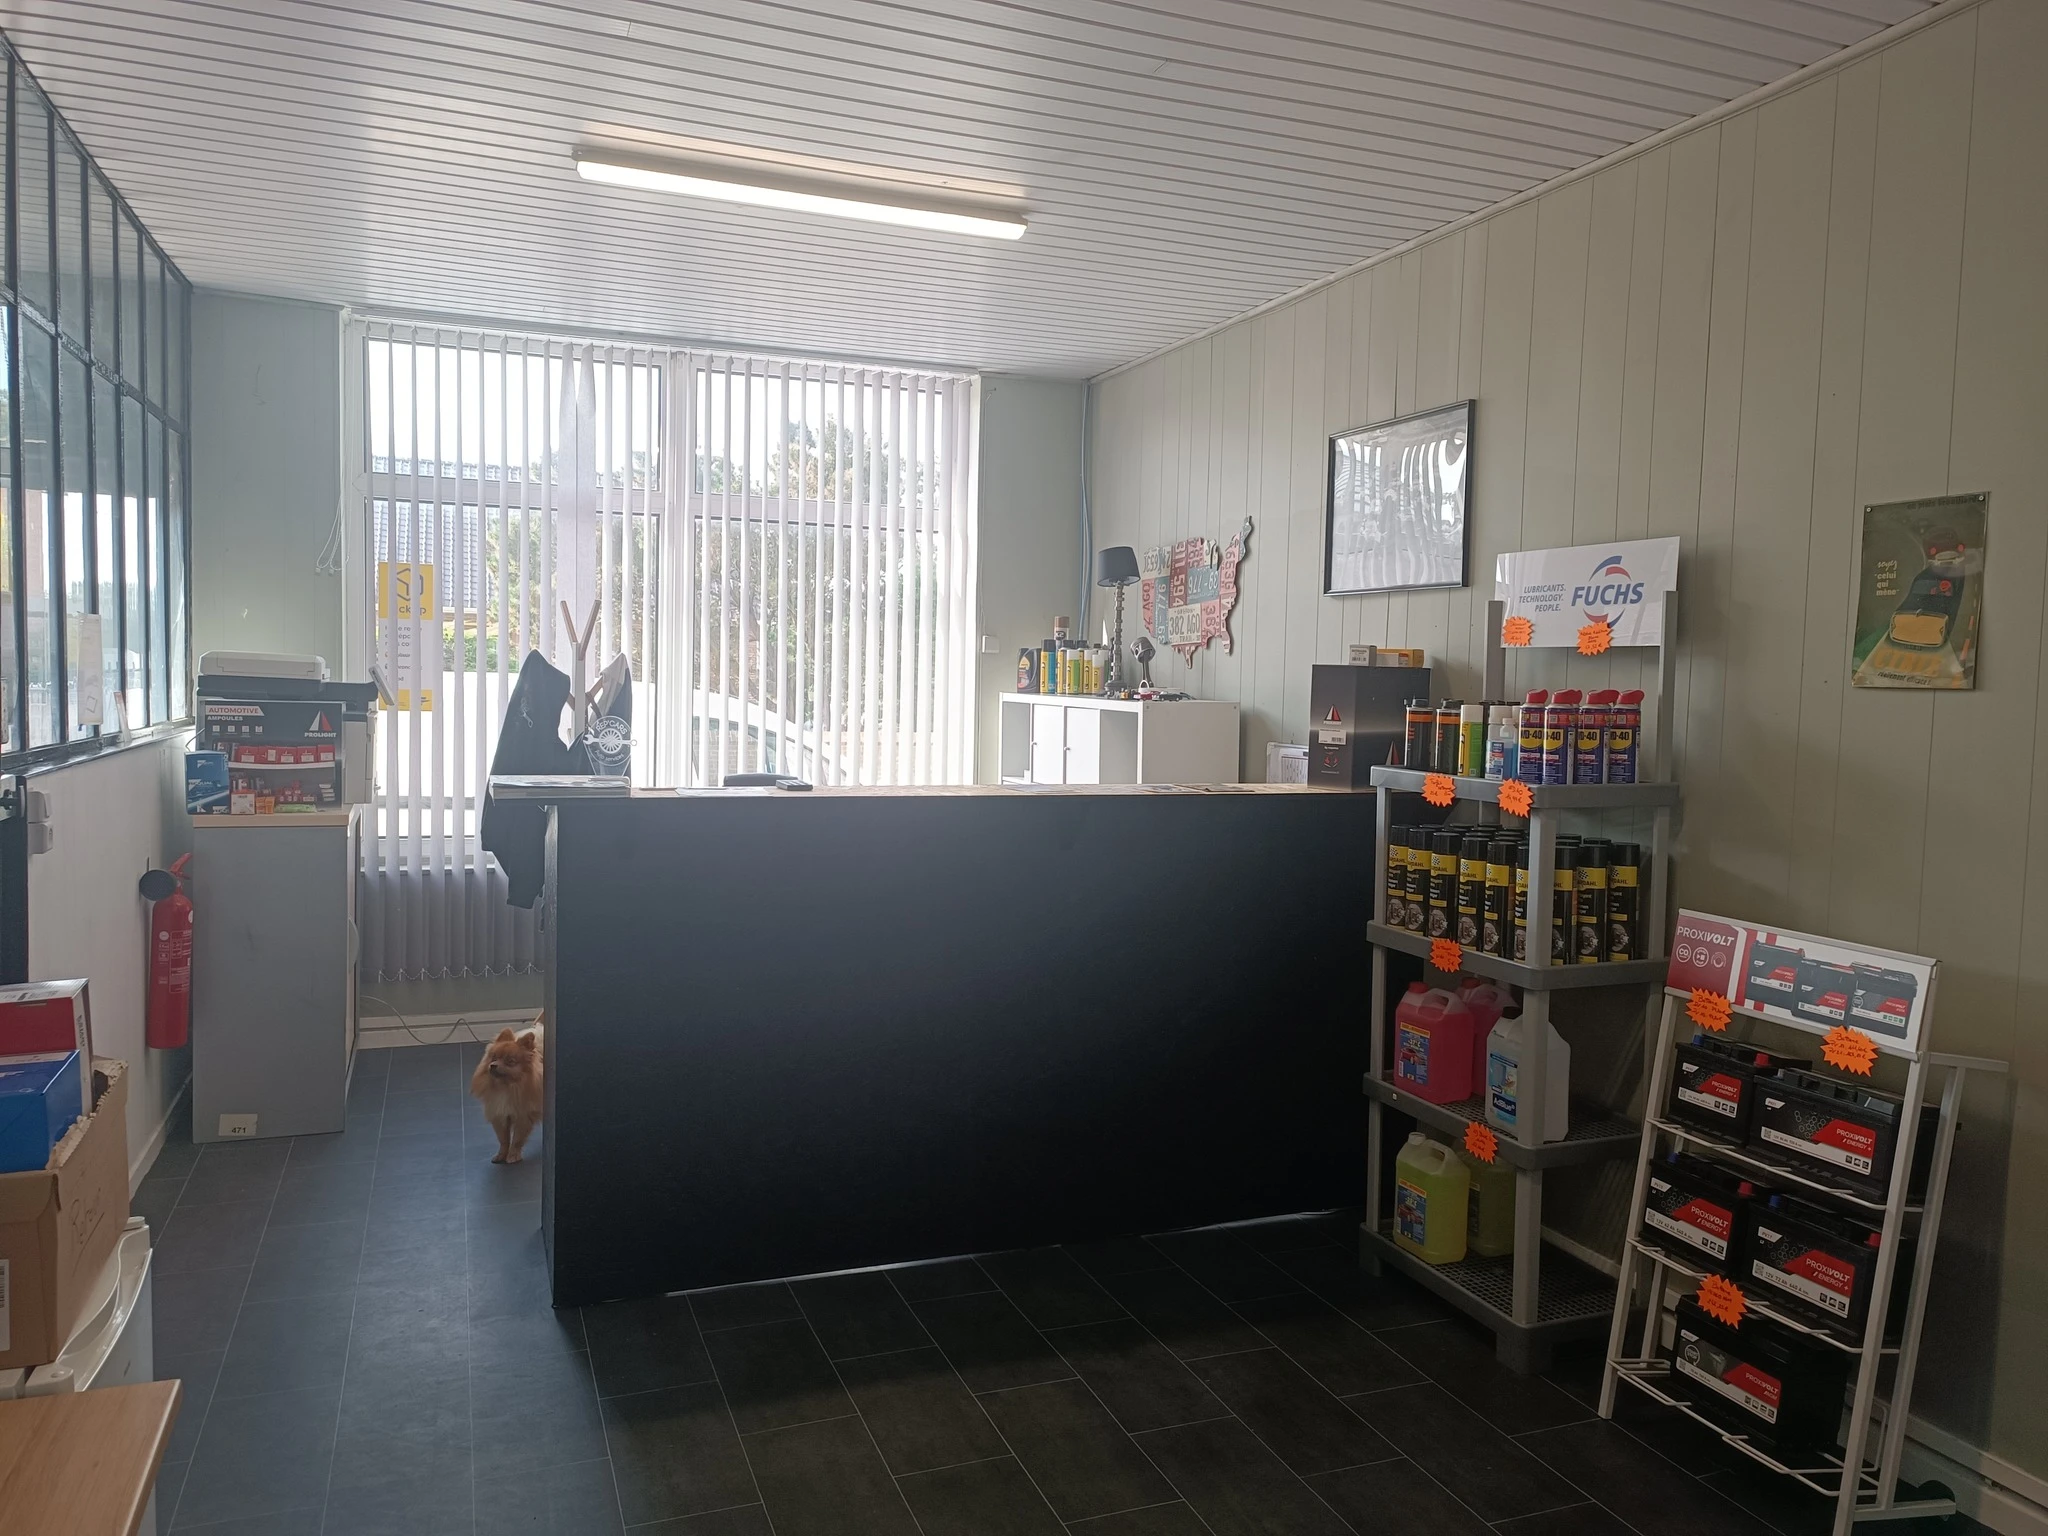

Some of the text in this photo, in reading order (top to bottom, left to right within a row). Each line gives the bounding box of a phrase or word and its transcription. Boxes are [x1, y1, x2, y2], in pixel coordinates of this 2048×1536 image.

[1524, 584, 1566, 593] LUBRICANTS.
[1877, 580, 1889, 589] qui
[1519, 594, 1564, 604] TECHNOLOGY.
[1571, 582, 1645, 607] FUCHS
[1535, 604, 1561, 612] PEOPLE.
[1169, 613, 1201, 636] 382 AGO
[1677, 926, 1735, 947] PROXIVOLT
[1711, 1080, 1738, 1093] PROXIVOLT
[1836, 1128, 1873, 1144] PROXIVOLT
[1846, 1139, 1867, 1150] ENERGY
[1691, 1206, 1729, 1228] PROXIVOLT
[1701, 1219, 1723, 1233] ENERGY
[1805, 1258, 1851, 1282] PROXIVOLT
[1818, 1273, 1844, 1288] ENERGY
[1745, 1372, 1779, 1395] PROXIVOLT
